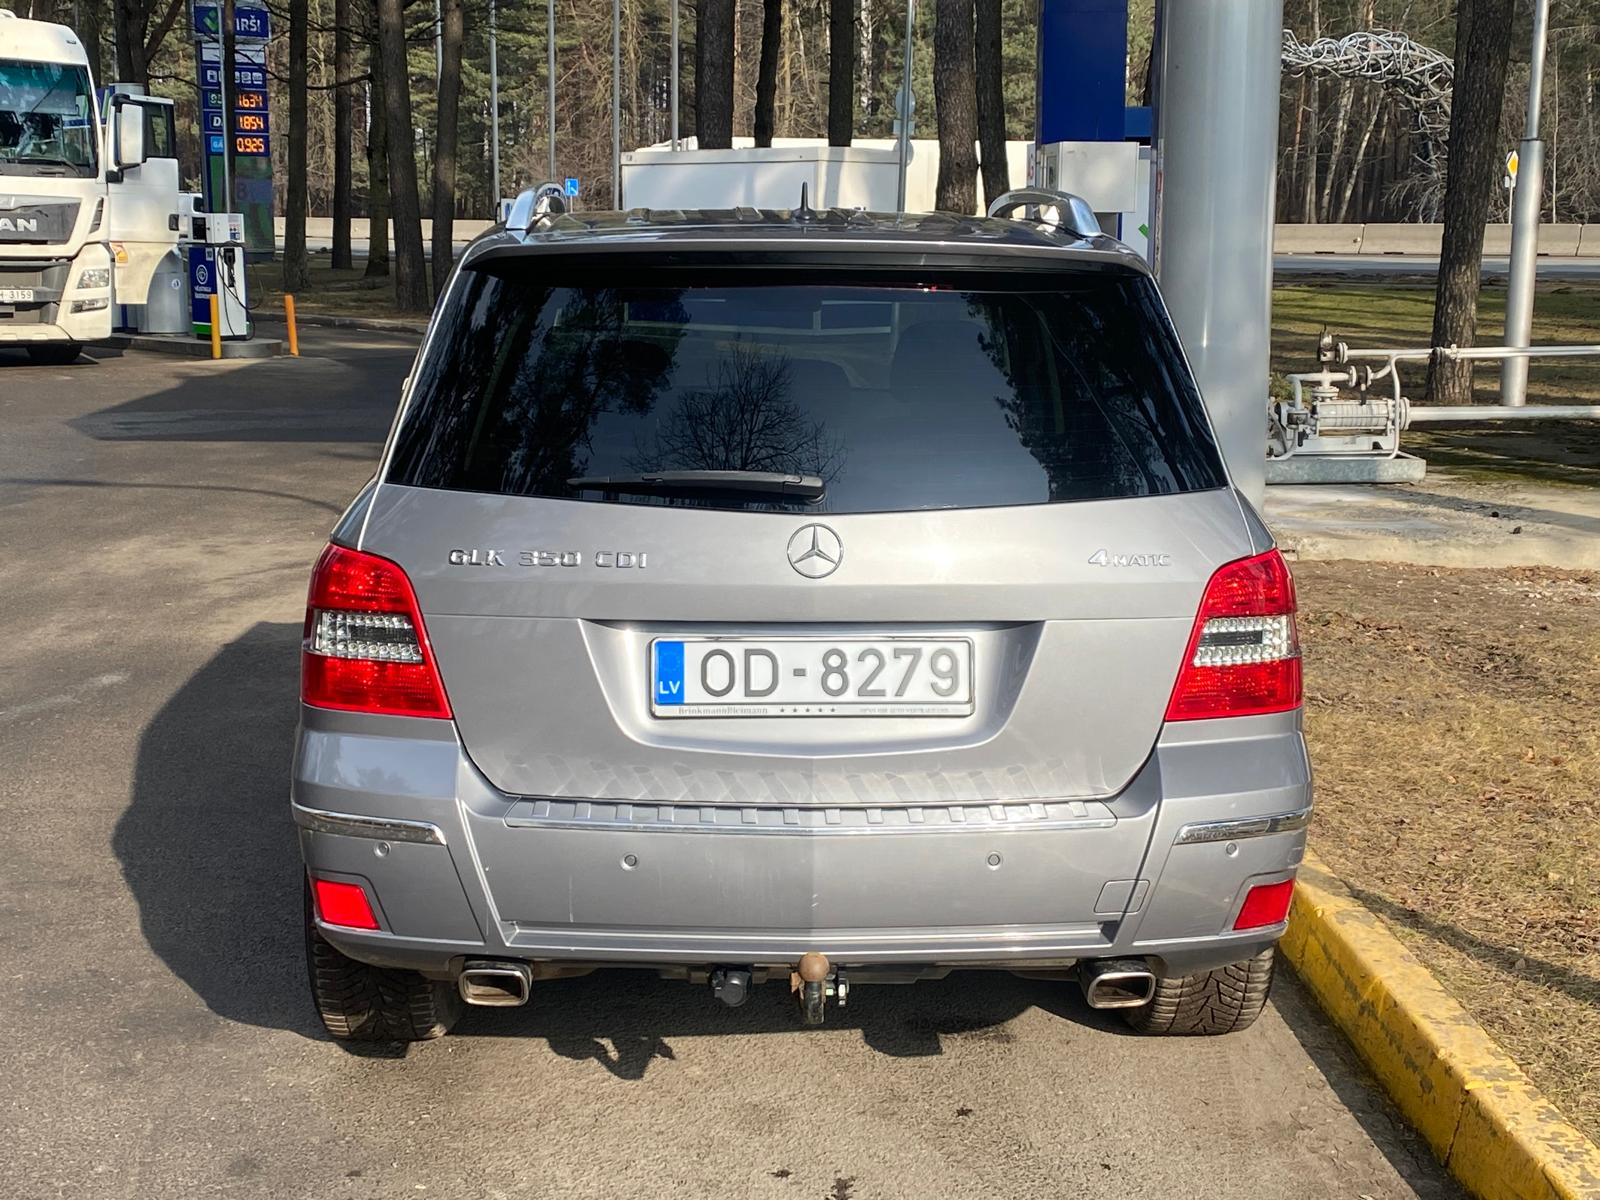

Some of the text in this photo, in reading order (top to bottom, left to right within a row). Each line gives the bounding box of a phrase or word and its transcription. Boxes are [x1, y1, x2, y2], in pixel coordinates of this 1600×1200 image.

[0, 217, 37, 232] AN
[449, 549, 648, 568] GLK 350 CDI
[1087, 549, 1170, 567] 4MATIC
[659, 648, 960, 698] LV OD-8279
